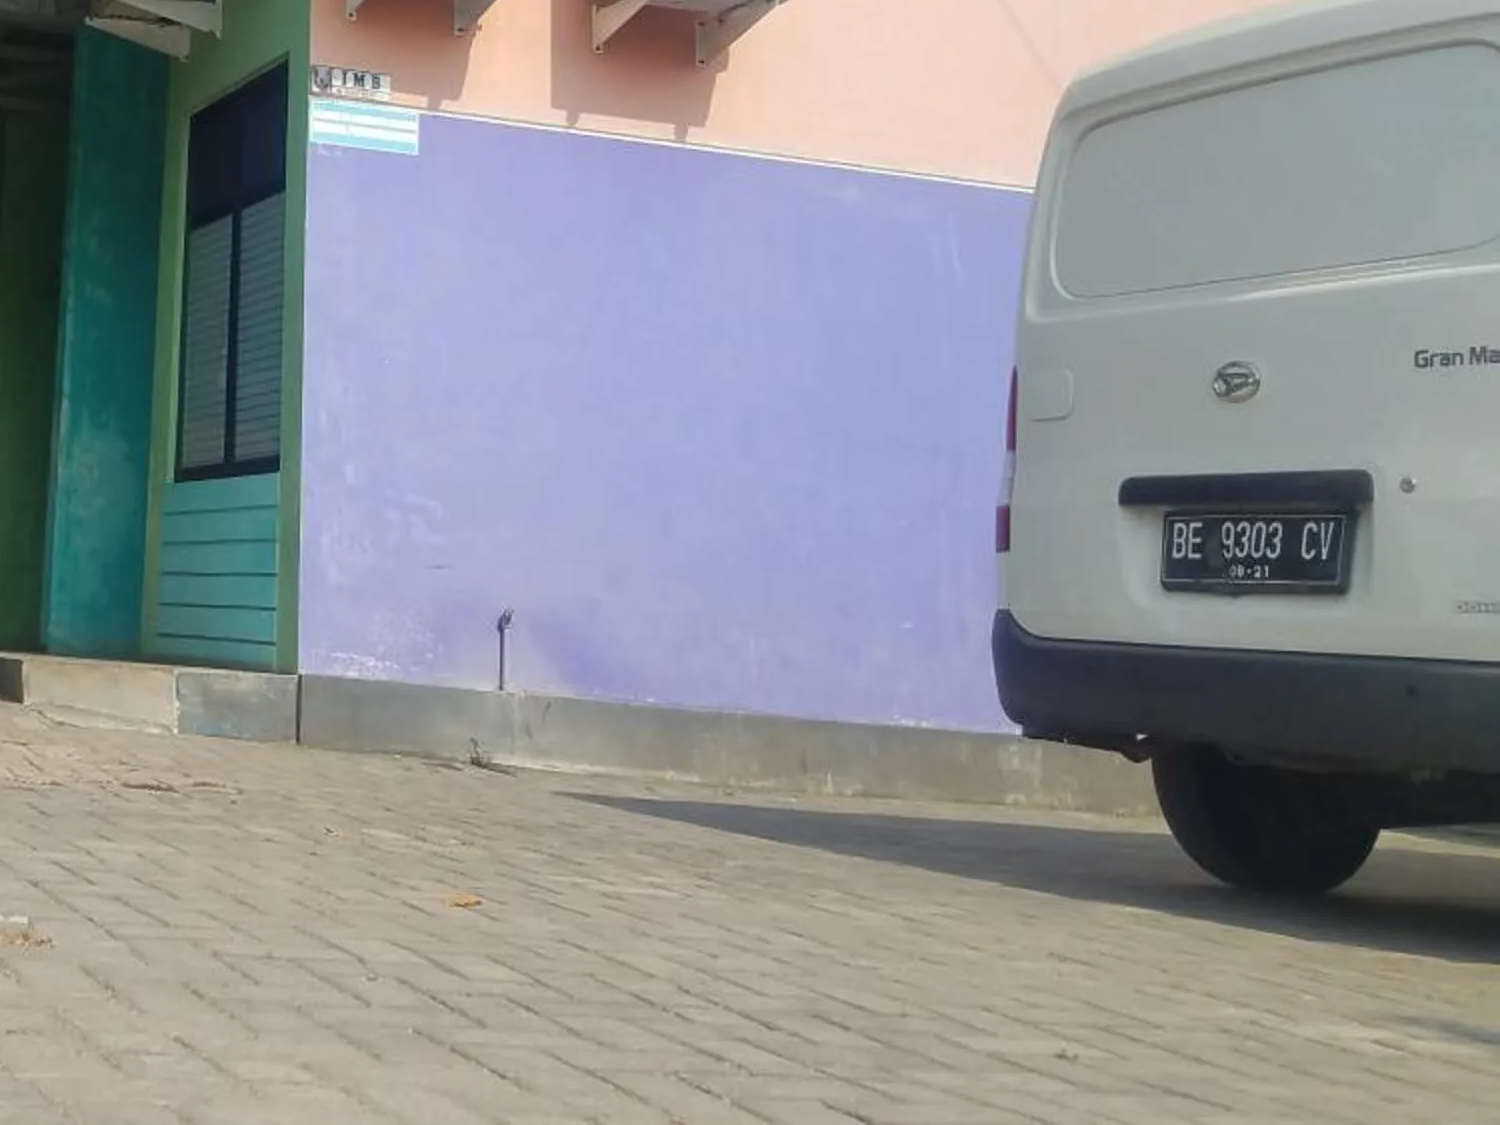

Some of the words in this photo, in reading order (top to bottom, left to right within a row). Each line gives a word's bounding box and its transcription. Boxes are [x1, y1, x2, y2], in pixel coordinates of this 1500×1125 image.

[1413, 349, 1465, 369] Gran
[1171, 522, 1203, 559] BE
[1221, 520, 1284, 559] 9303
[1301, 521, 1335, 561] CV
